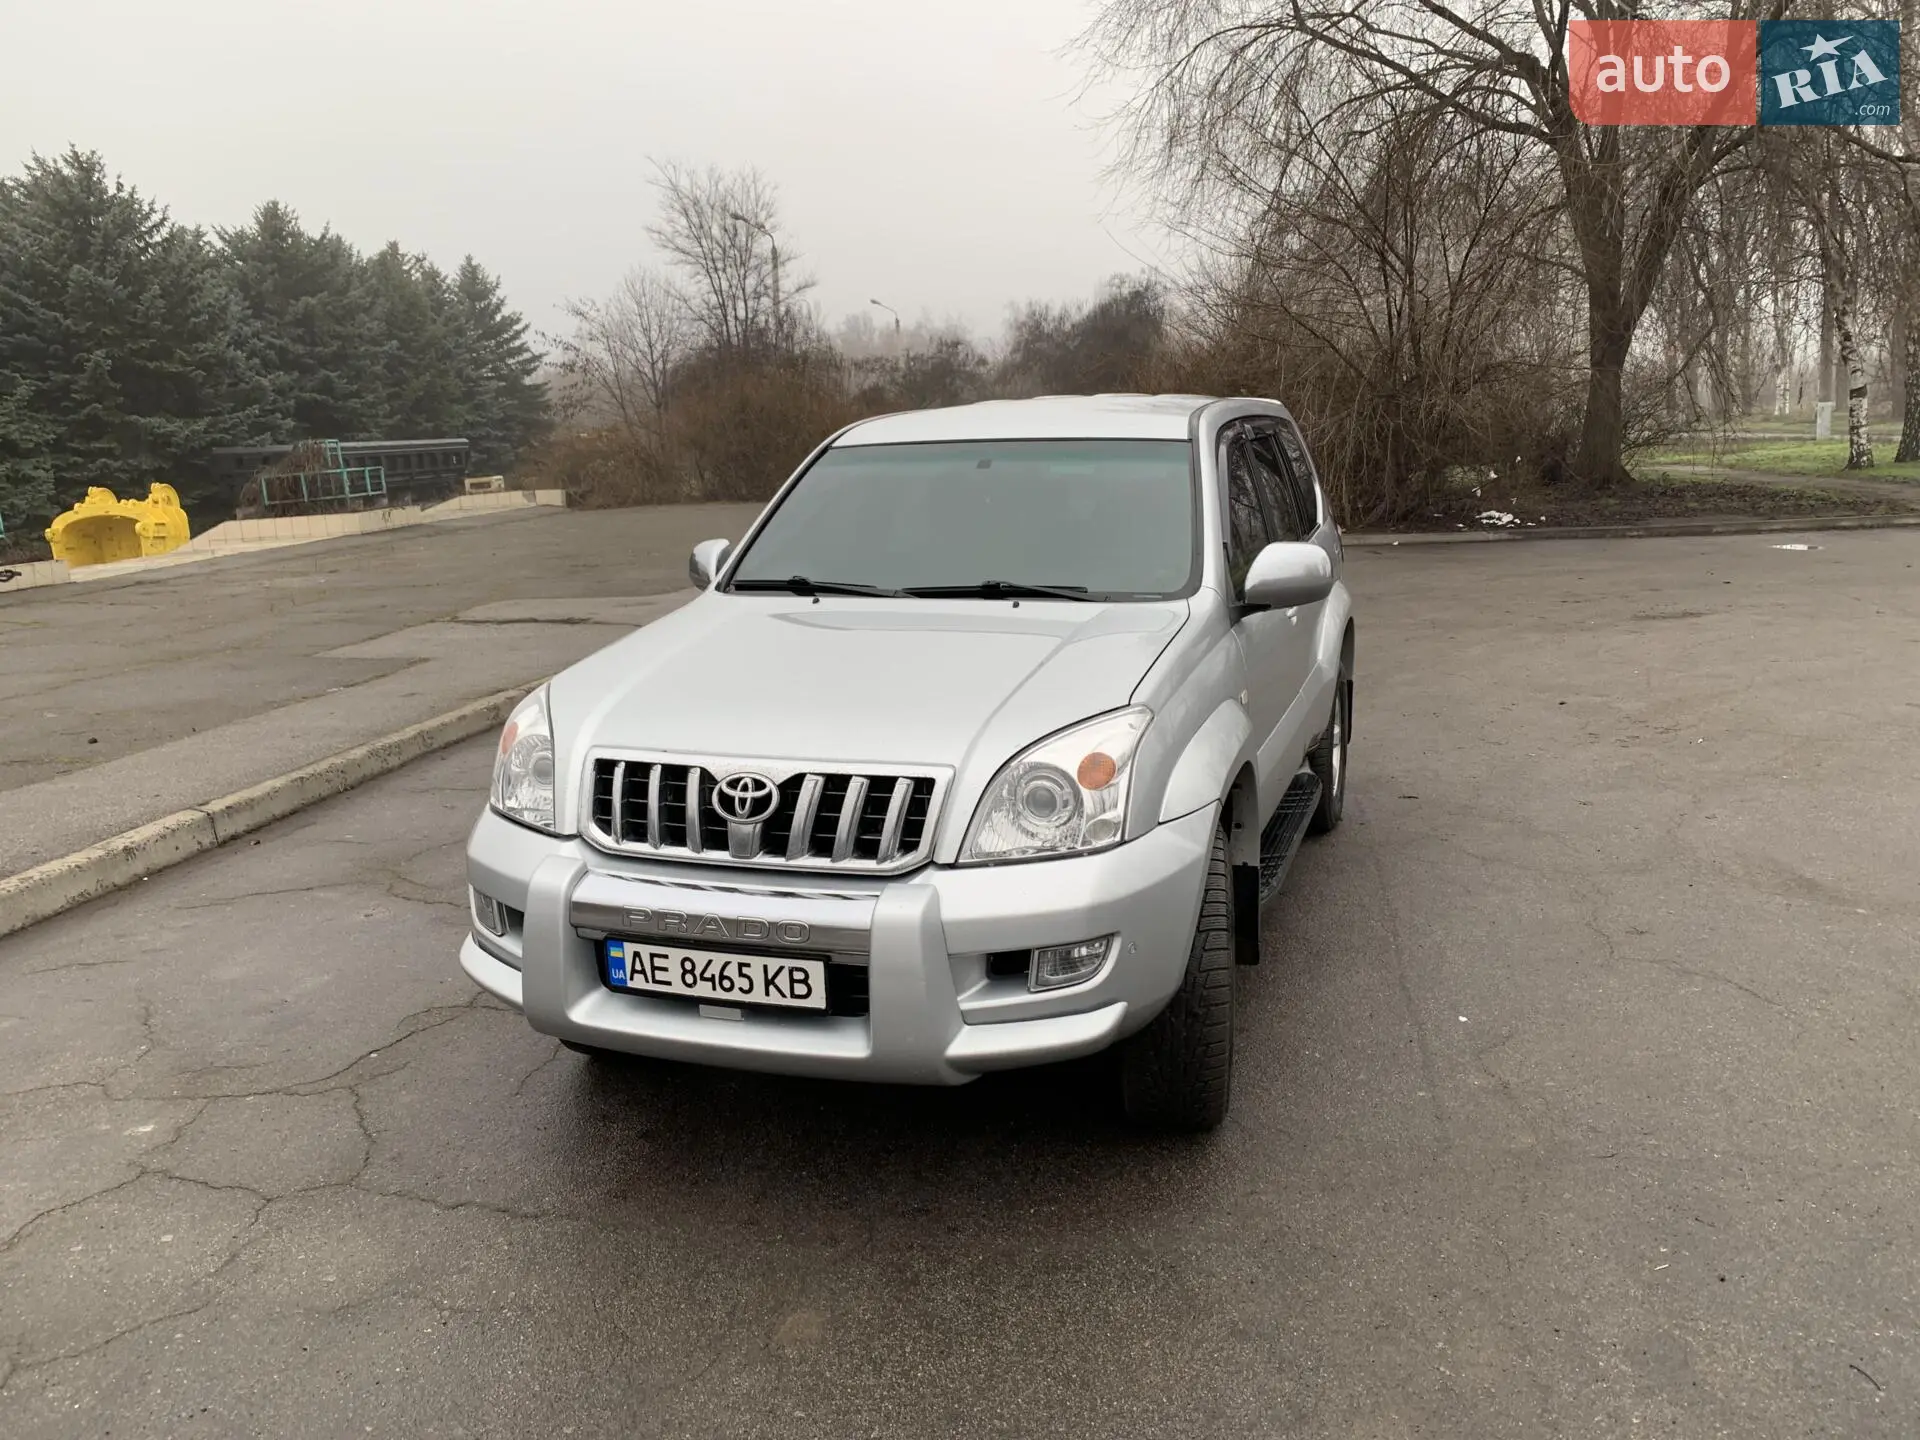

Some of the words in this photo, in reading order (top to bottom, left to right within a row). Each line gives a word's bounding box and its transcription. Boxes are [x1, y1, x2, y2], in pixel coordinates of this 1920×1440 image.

[622, 905, 811, 944] PRADO
[611, 967, 626, 980] UA
[629, 950, 673, 987] AE
[680, 956, 754, 995] 8465
[763, 964, 813, 1000] KB
